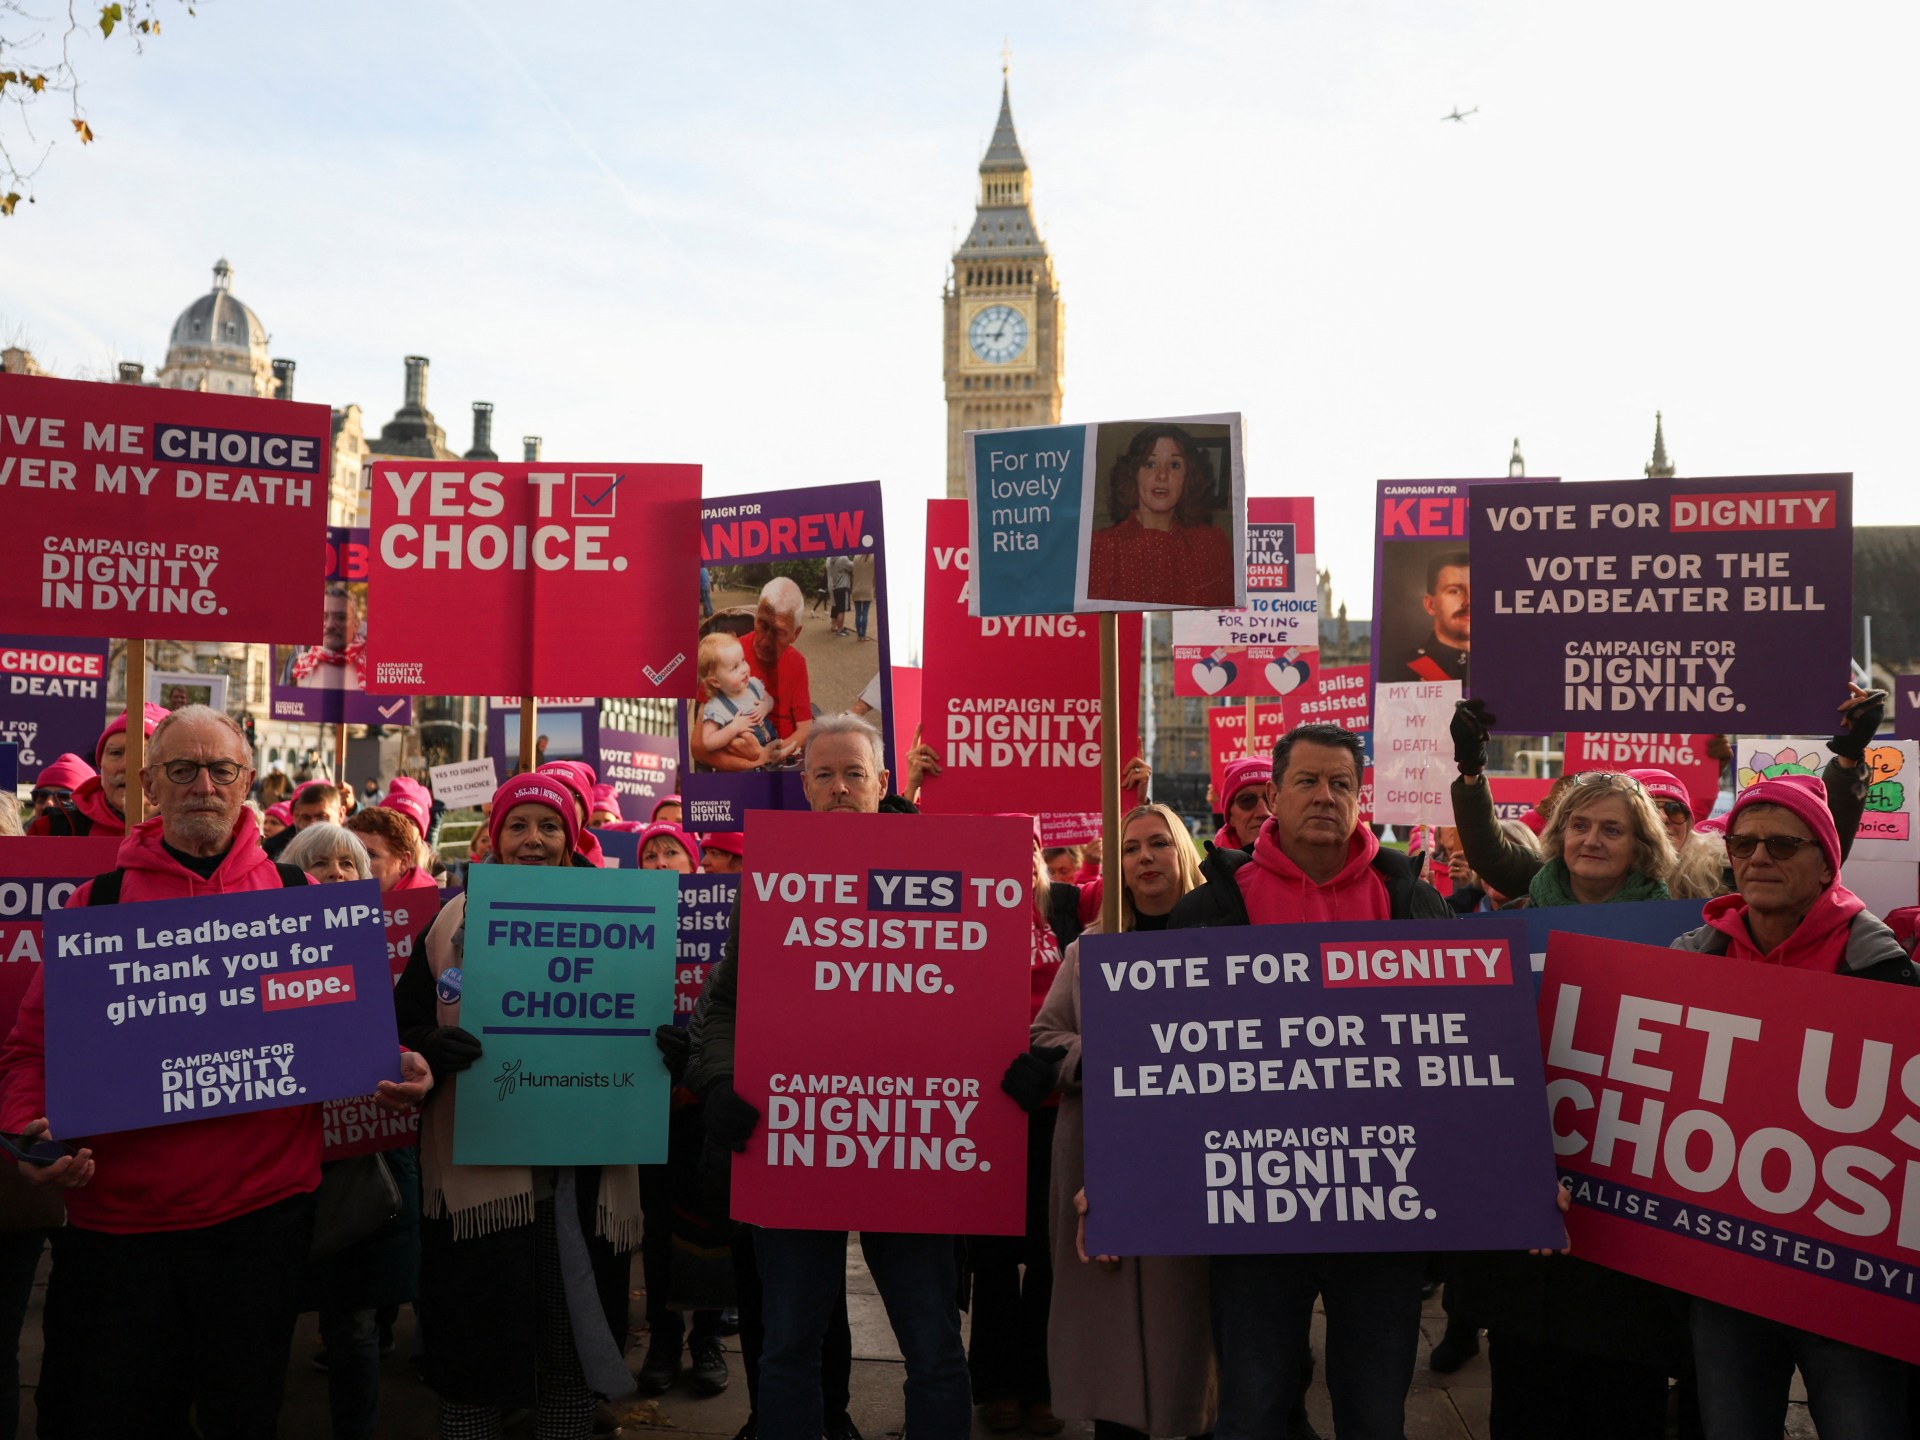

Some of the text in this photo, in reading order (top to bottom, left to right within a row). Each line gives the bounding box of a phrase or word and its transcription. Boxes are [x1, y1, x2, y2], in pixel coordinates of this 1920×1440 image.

[0, 414, 315, 468] VE ME CHOICE
[990, 449, 1071, 473] For my
[0, 456, 313, 508] VER MY DEATH
[383, 471, 505, 518] YES
[991, 475, 1062, 500] lovely
[1384, 485, 1457, 495] CAMPAIGN FOR
[701, 503, 762, 520] PAIGN FOR
[992, 504, 1051, 526] mum
[1383, 497, 1469, 536] KEI
[1485, 497, 1830, 532] VOTE FOR DIGNITY
[993, 531, 1039, 553] Rita
[1262, 530, 1284, 538] FOR
[43, 535, 220, 562] CAMPAIGN FOR
[379, 523, 629, 572] CHOICE.
[932, 546, 969, 571] VO
[42, 552, 219, 588] DIGNITY
[1525, 552, 1791, 582] VOTE FOR THE
[1247, 576, 1284, 587] OTTS
[41, 581, 229, 617] IN DYING.
[1251, 599, 1268, 612] TO
[1271, 599, 1318, 613] CHOICE
[1494, 585, 1826, 616] LEADBEATER BILL
[981, 614, 1087, 638] DYING.
[1217, 615, 1299, 628] FOR DYING
[1230, 631, 1288, 644] PEOPLE
[1564, 640, 1736, 656] CAMPAIGN FOR
[1, 650, 100, 676] CHOICE
[376, 667, 423, 677] DIGNITY
[1564, 656, 1736, 685] DIGNITY
[10, 675, 98, 699] DEATH
[376, 675, 426, 685] IN DYING.
[1318, 674, 1365, 695] galise
[1389, 685, 1443, 700] MY LIFE
[947, 698, 1056, 714] CAMPAIGN
[1300, 692, 1367, 715] assisted
[1564, 686, 1747, 713] IN DYING.
[947, 714, 1101, 741] DIGNITY
[1215, 715, 1247, 728] VOT
[1406, 715, 1427, 728] MY
[946, 742, 1101, 768] IN DYING
[1393, 739, 1438, 752] DEATH
[1583, 742, 1702, 767] IN DYING.
[600, 748, 677, 770] VOTE YES TO
[606, 765, 666, 784] ASSISTED
[1405, 767, 1426, 780] MY
[615, 780, 656, 798] DYING.
[1387, 790, 1442, 804] CHOICE
[690, 805, 731, 814] DIGNITY
[691, 813, 735, 822] IN DYING.
[0, 882, 77, 916] OIC
[751, 872, 1023, 909] VOTE YES TO
[57, 931, 123, 958] Kim
[136, 913, 311, 950] Leadbeater
[323, 904, 381, 930] MP:
[487, 920, 655, 950] FREEDOM
[783, 917, 988, 951] ASSISTED
[676, 938, 711, 962] ing
[108, 942, 333, 987] Thank you for
[547, 956, 594, 983] OF
[814, 960, 955, 995] DYING.
[1099, 957, 1210, 992] VOTE
[1225, 952, 1311, 986] FOR
[1326, 947, 1503, 982] DIGNITY
[106, 974, 351, 1026] giving us hope.
[501, 990, 636, 1020] CHOICE
[1150, 1013, 1470, 1054] VOTE FOR THE
[1546, 982, 1763, 1105] LET
[160, 1043, 295, 1071] CAMPAIGN FOR
[161, 1055, 295, 1093] DIGNITY
[519, 1071, 635, 1088] Humanists UK
[769, 1073, 980, 1099] CAMPAIGN FOR
[1112, 1054, 1516, 1098] LEADBEATER BILL
[162, 1076, 307, 1114] IN DYING.
[346, 1113, 421, 1143] DYING
[768, 1096, 979, 1135] DIGNITY
[1204, 1124, 1417, 1150] CAMPAIGN FOR
[766, 1132, 992, 1173] IN DYING.
[1204, 1147, 1417, 1188] DIGNITY
[1206, 1185, 1438, 1225] IN DYING.
[1558, 1175, 1914, 1296] GALISE ASSISTED DYI
